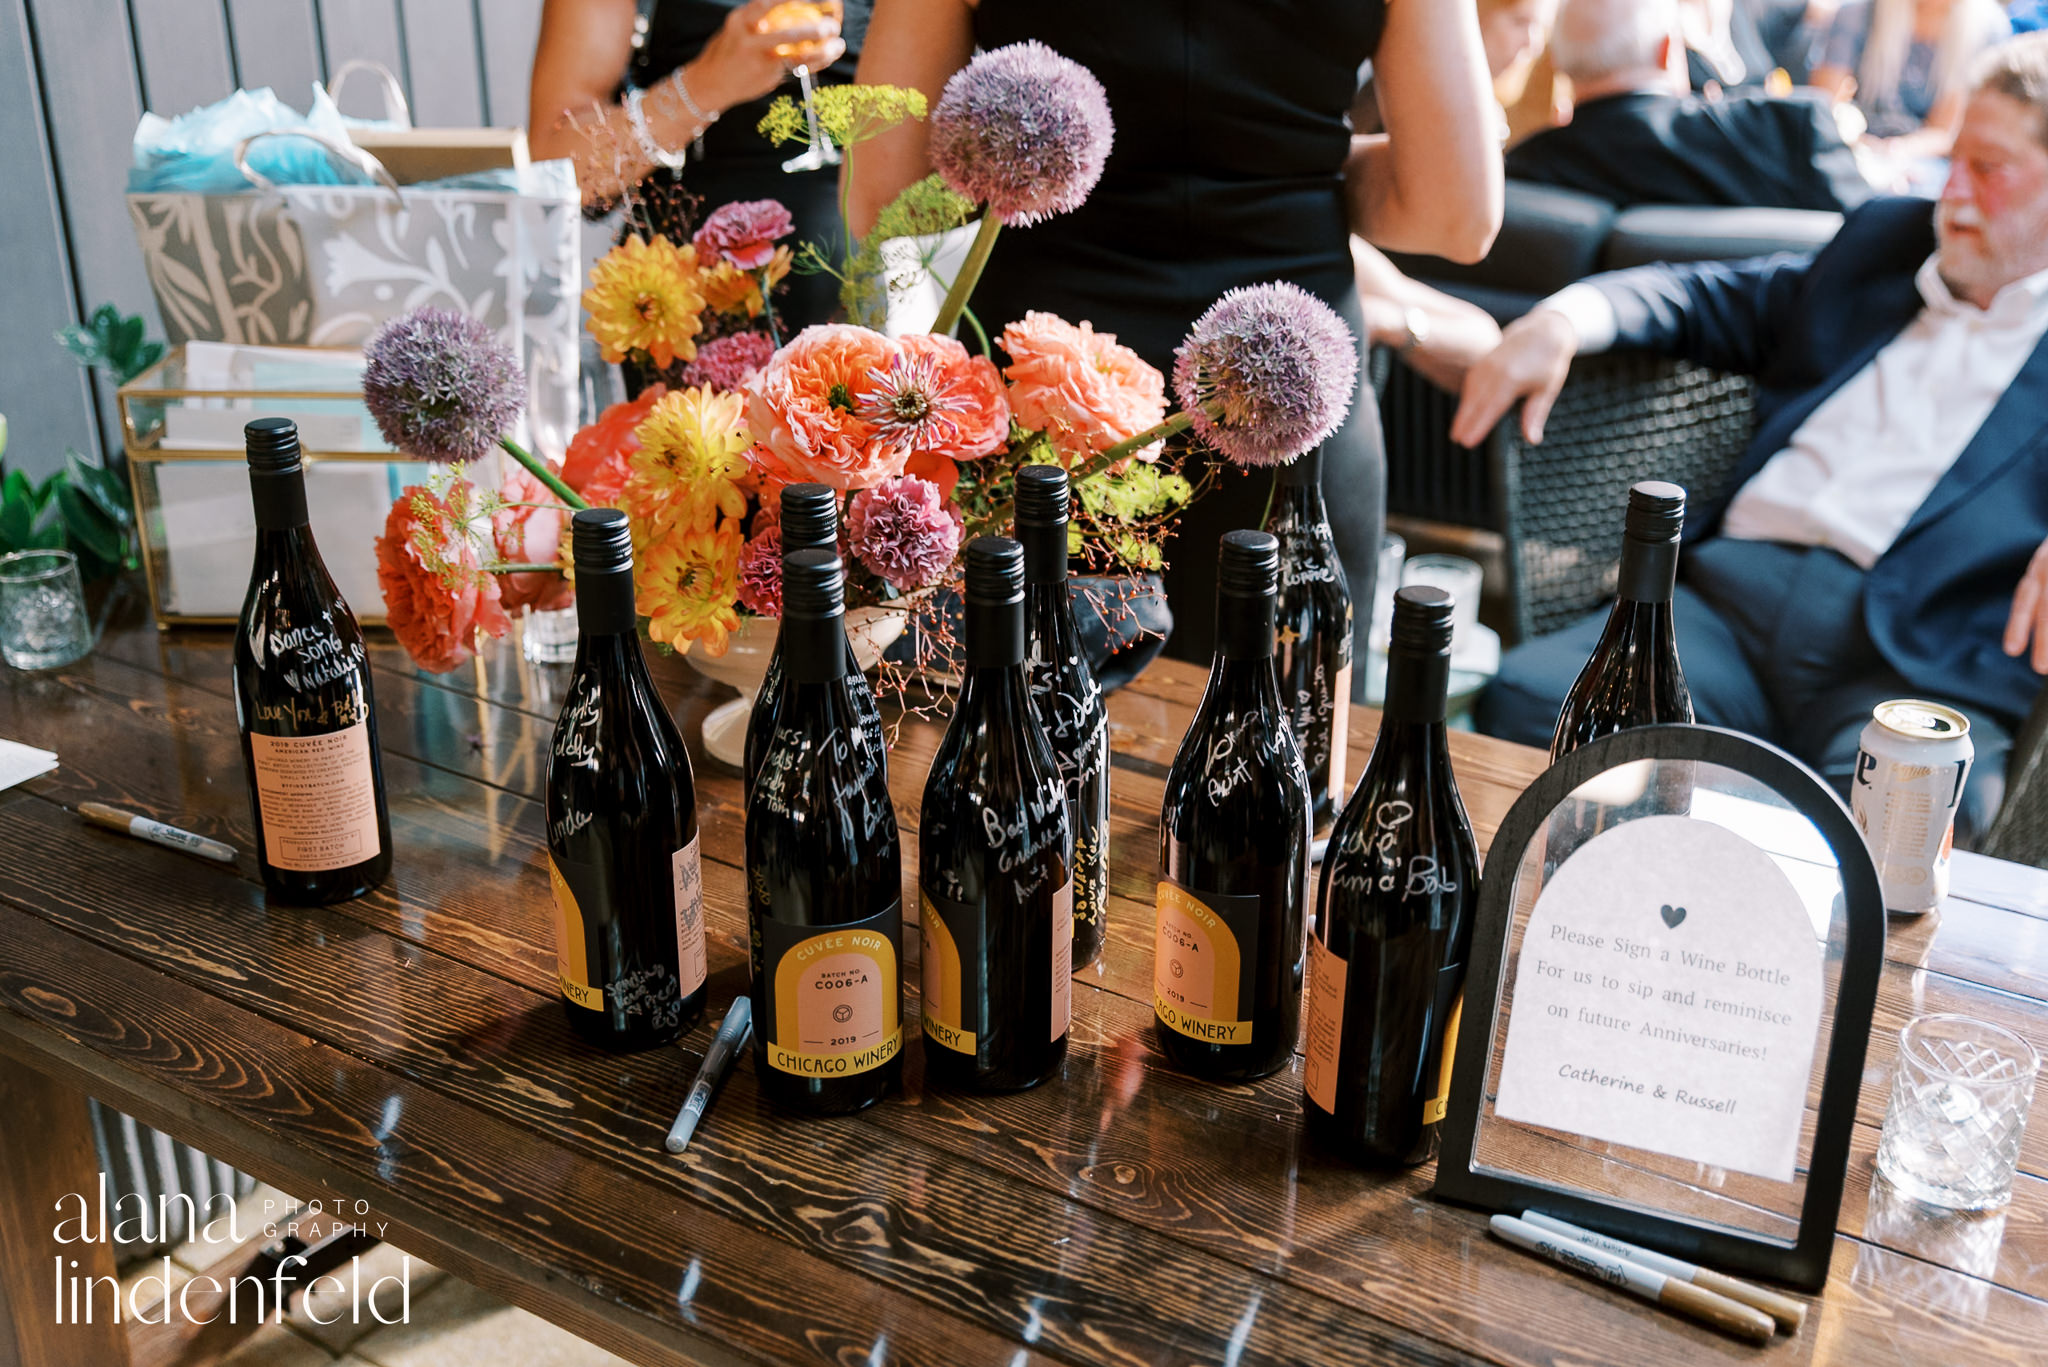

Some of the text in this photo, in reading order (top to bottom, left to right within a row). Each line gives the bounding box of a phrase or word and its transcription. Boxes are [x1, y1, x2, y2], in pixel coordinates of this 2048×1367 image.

[1186, 901, 1216, 928] NOIR
[797, 935, 881, 961] CUVÉE NOIR
[1550, 924, 1791, 987] Please Sign a Wine Bottle
[1536, 959, 1792, 1026] For us to sip and reminisce
[830, 1035, 857, 1046] 2019
[1181, 1015, 1237, 1041] WINERY
[1547, 1004, 1767, 1061] on future Anniversaries!
[777, 1037, 899, 1073] CHICAGO WINERY
[1558, 1063, 1737, 1115] Catherine & Russell
